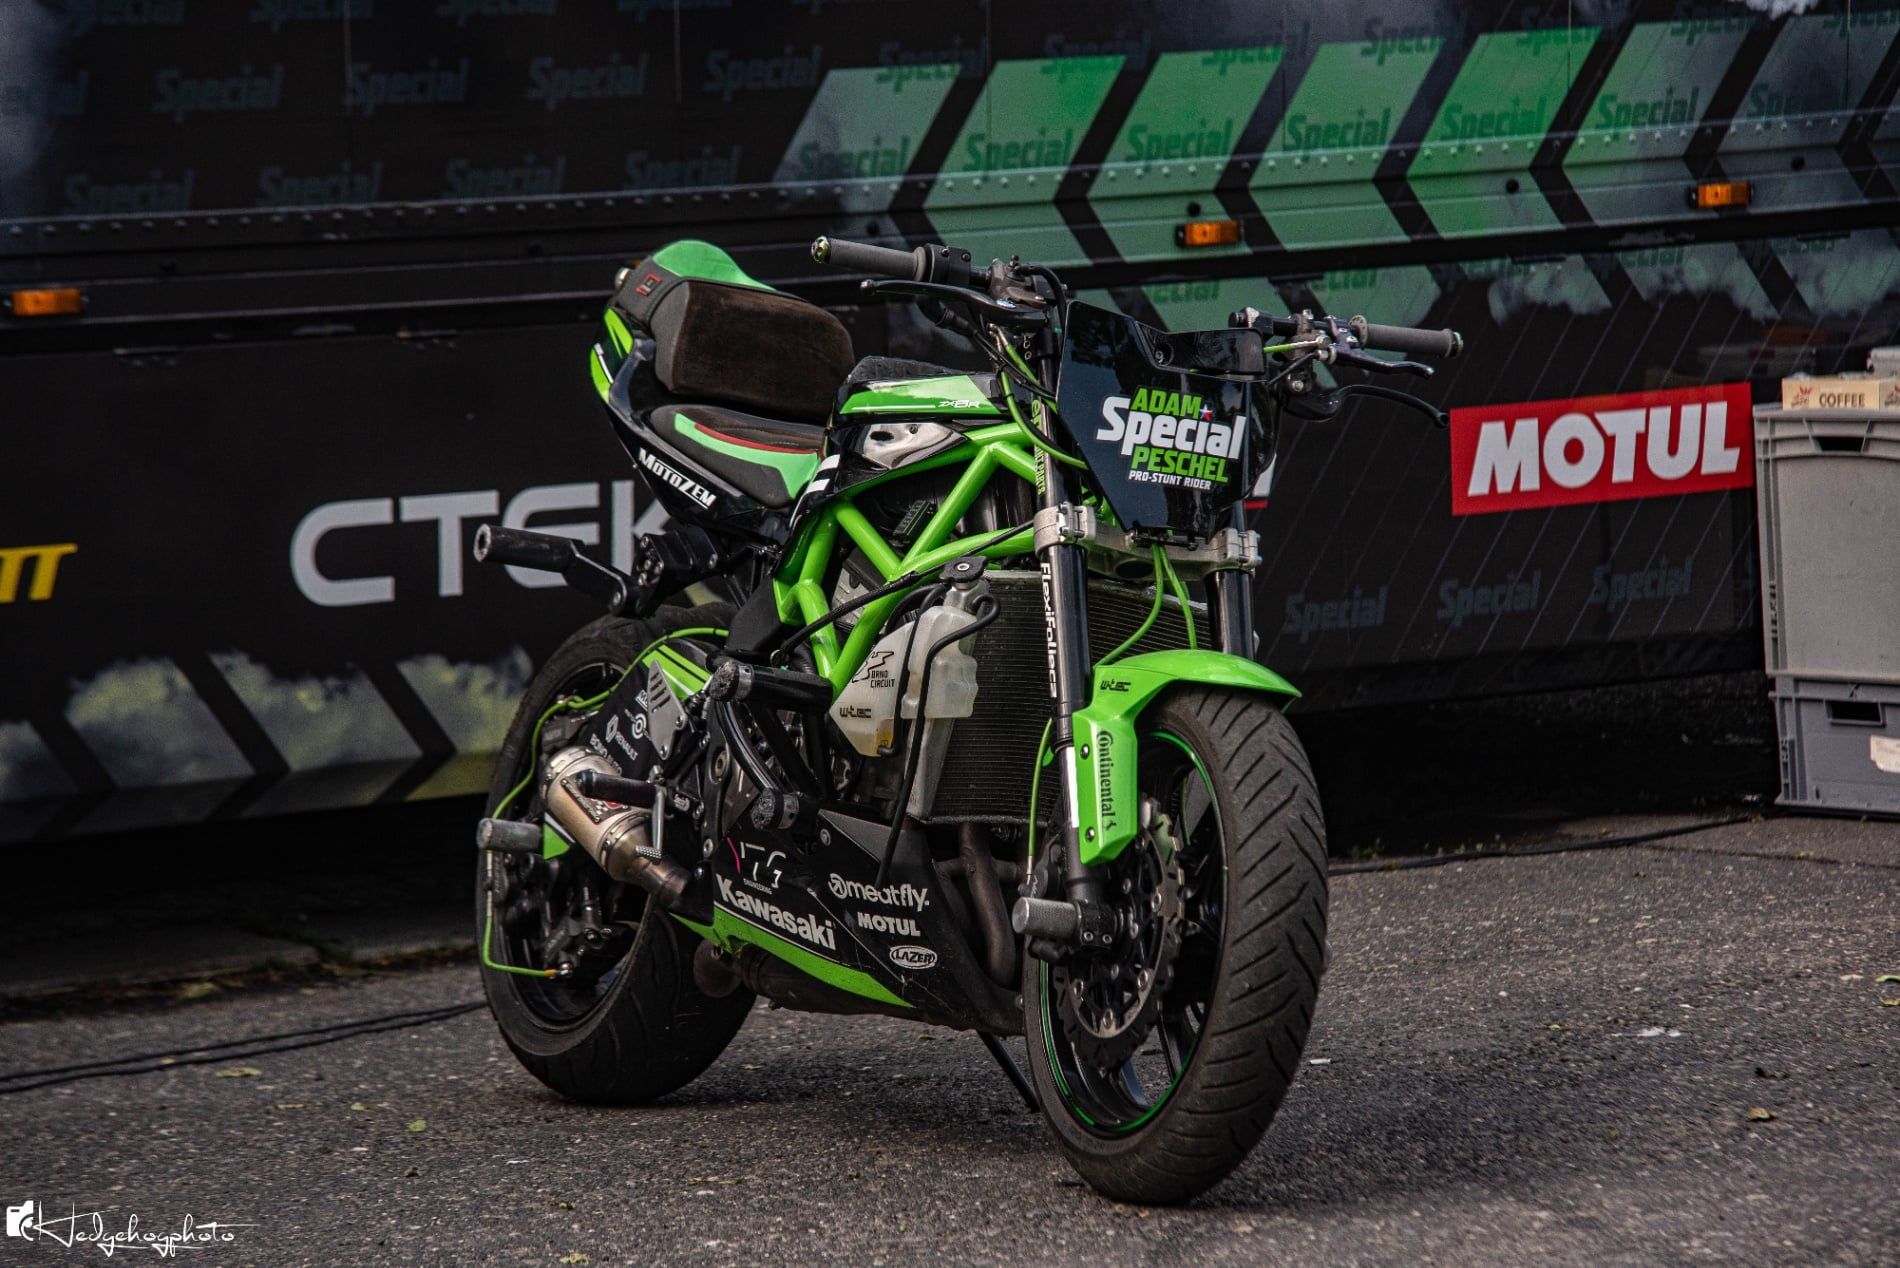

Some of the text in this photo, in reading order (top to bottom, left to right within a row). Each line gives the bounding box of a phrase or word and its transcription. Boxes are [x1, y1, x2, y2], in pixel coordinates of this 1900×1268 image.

[152, 64, 284, 123] Special
[345, 61, 470, 117] Special
[527, 53, 649, 111] Special
[704, 45, 823, 101] Special
[1283, 105, 1391, 151] Special
[1440, 95, 1547, 141] Special
[1596, 82, 1699, 130] Special
[964, 127, 1073, 172] Special
[1123, 117, 1234, 163] Special
[1131, 387, 1202, 419] ADAM
[1818, 392, 1866, 408] COFFEE
[1096, 396, 1247, 460] Special
[1467, 400, 1741, 498] MOTUL
[1128, 470, 1212, 491] PRO-STUNT RIDER
[1131, 446, 1229, 484] PESCHEL
[1437, 569, 1541, 629] Special
[1593, 553, 1695, 612] Special
[1282, 583, 1389, 644] Special
[870, 679, 896, 689] CIRCUIT
[1096, 730, 1116, 818] Continental
[715, 873, 837, 951] Kawasaki
[856, 911, 922, 937] MOTUL
[893, 949, 937, 965] LAZER
